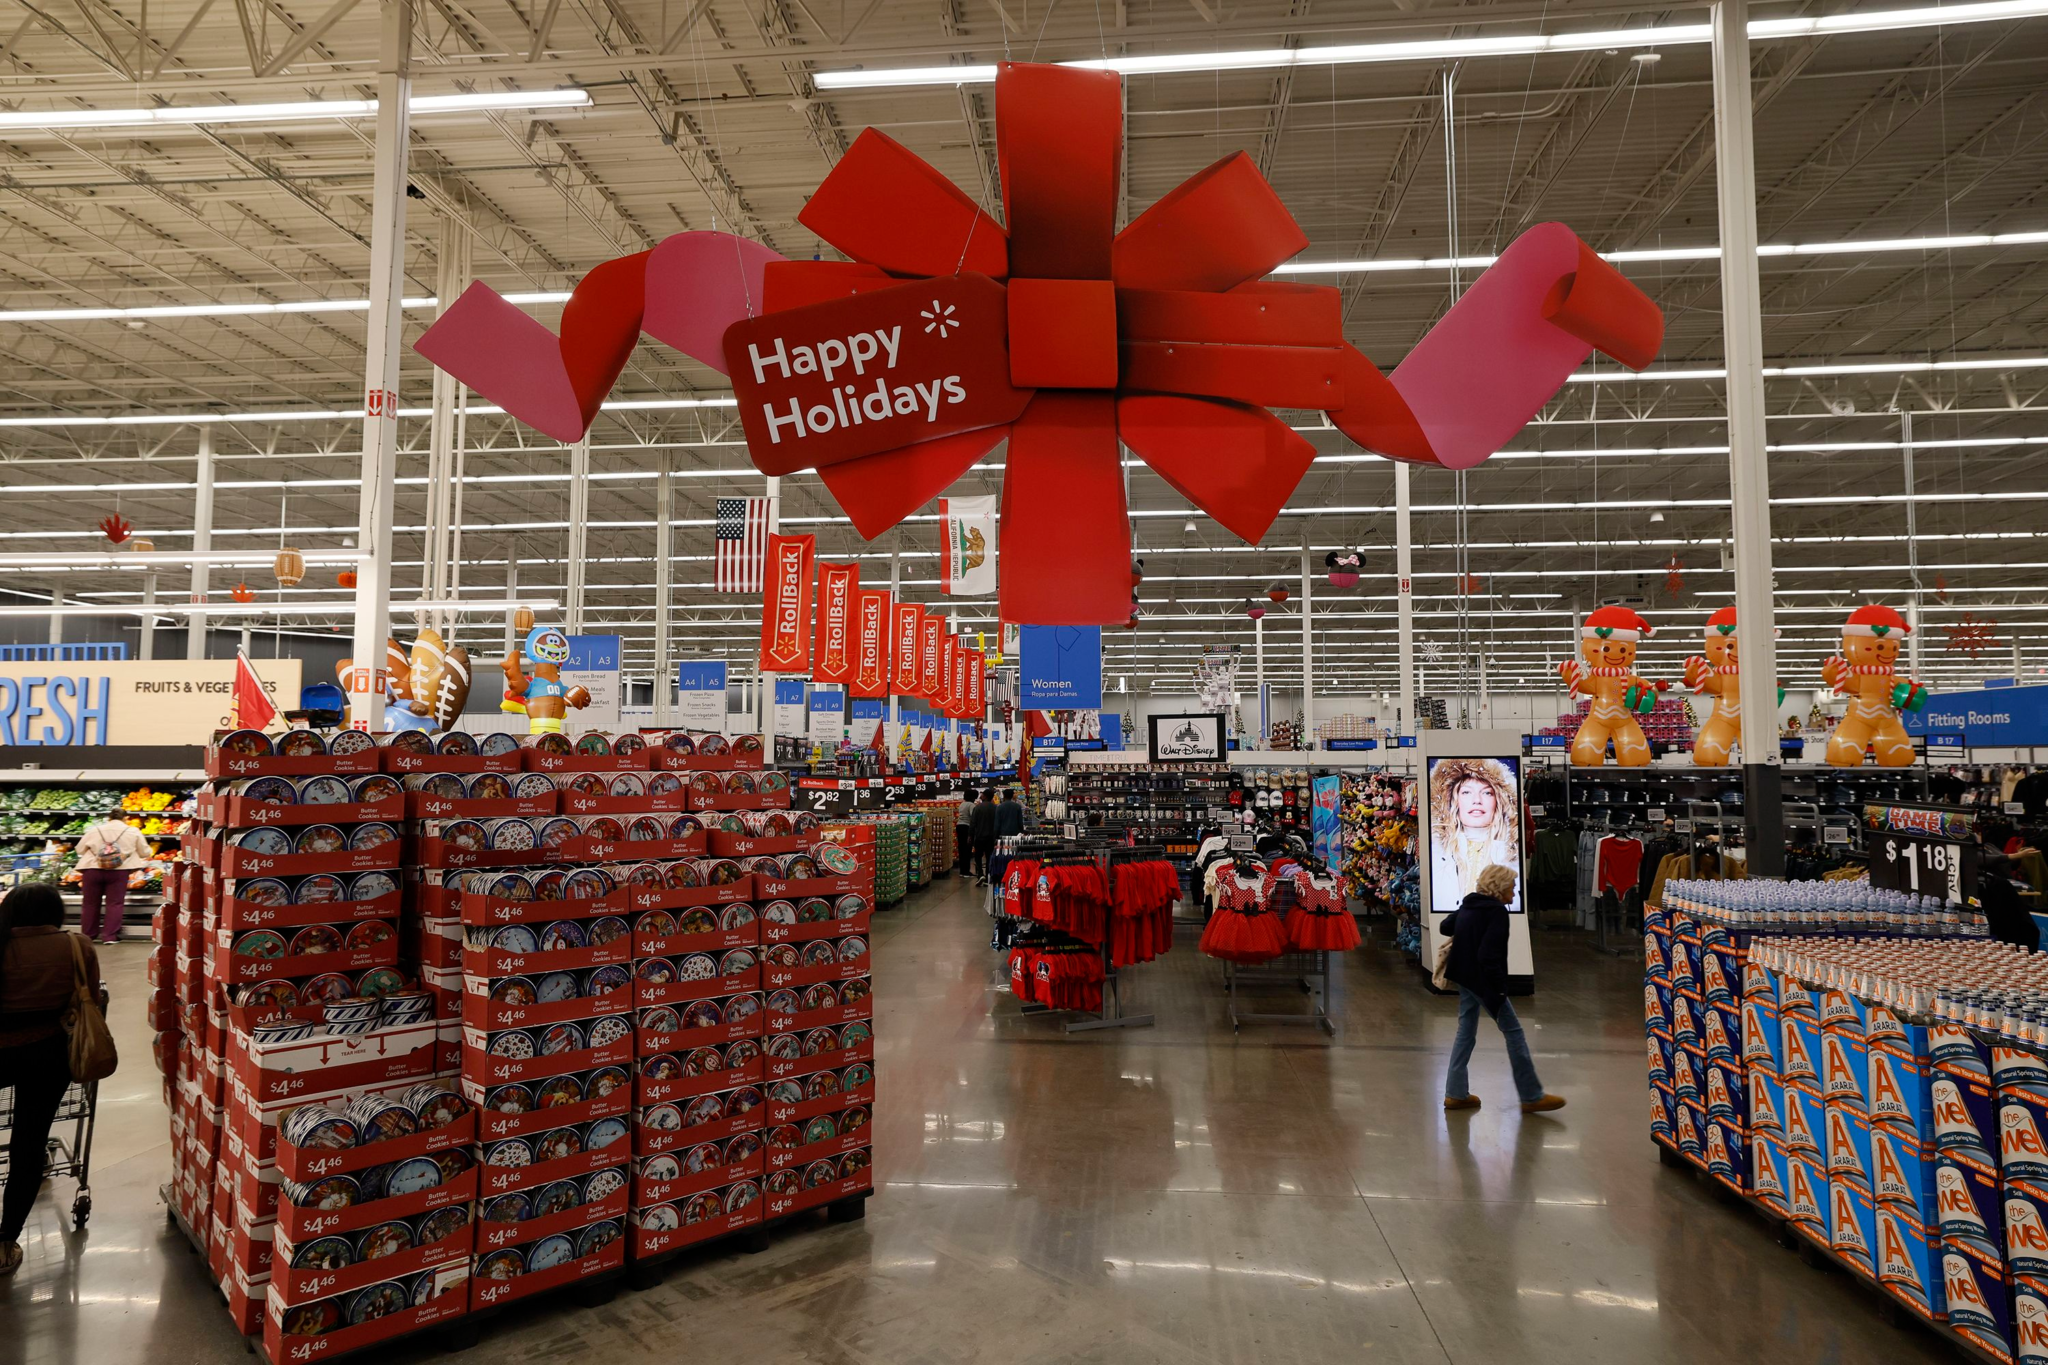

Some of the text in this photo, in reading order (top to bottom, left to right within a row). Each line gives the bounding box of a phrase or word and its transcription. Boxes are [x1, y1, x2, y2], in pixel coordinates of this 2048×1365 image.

[748, 325, 901, 384] Happy
[763, 375, 967, 444] Holidays
[950, 515, 958, 550] CALIFORNIA
[780, 550, 800, 634] RollBack
[829, 577, 846, 650] RollBack
[864, 603, 878, 668] RollBack
[902, 615, 914, 670] RollBack
[926, 625, 937, 676] RollBack
[568, 656, 581, 666] A2
[598, 656, 611, 665] A3
[684, 678, 696, 686] A4
[708, 678, 719, 686] A5
[969, 660, 977, 699] RollBack
[1031, 678, 1072, 689] Women
[135, 681, 277, 693] FRUITS & VEGEES
[1927, 711, 2010, 729] Fitting Rooms
[1043, 738, 1056, 746] B17
[1937, 737, 1944, 745] B
[1890, 807, 1942, 821] GAME
[1890, 817, 1942, 834] TIME
[1827, 1007, 1850, 1016] ARARAT
[1873, 1022, 1897, 1031] ARARAT
[1749, 1045, 1766, 1053] ARARAT
[1882, 1043, 1893, 1051] Open
[1901, 1051, 1913, 1060] World
[1946, 1064, 1991, 1083] Taste Your World
[1935, 1086, 1947, 1096] the
[2015, 1088, 2047, 1105] Taste Your
[1877, 1102, 1902, 1112] ARARAT
[2003, 1112, 2019, 1121] the
[1791, 1134, 1810, 1143] ARARAT
[1834, 1157, 1857, 1167] ARARAT
[1953, 1152, 1997, 1175] Taste Your World
[1883, 1184, 1907, 1195] ARARAT
[2009, 1205, 2025, 1216] the
[1839, 1233, 1862, 1245] ARARAT
[1946, 1259, 1959, 1270] the
[1888, 1264, 1913, 1279] ARARAT
[1896, 1288, 1931, 1317] Open Your World
[1966, 1330, 2012, 1363] Taste Your World
